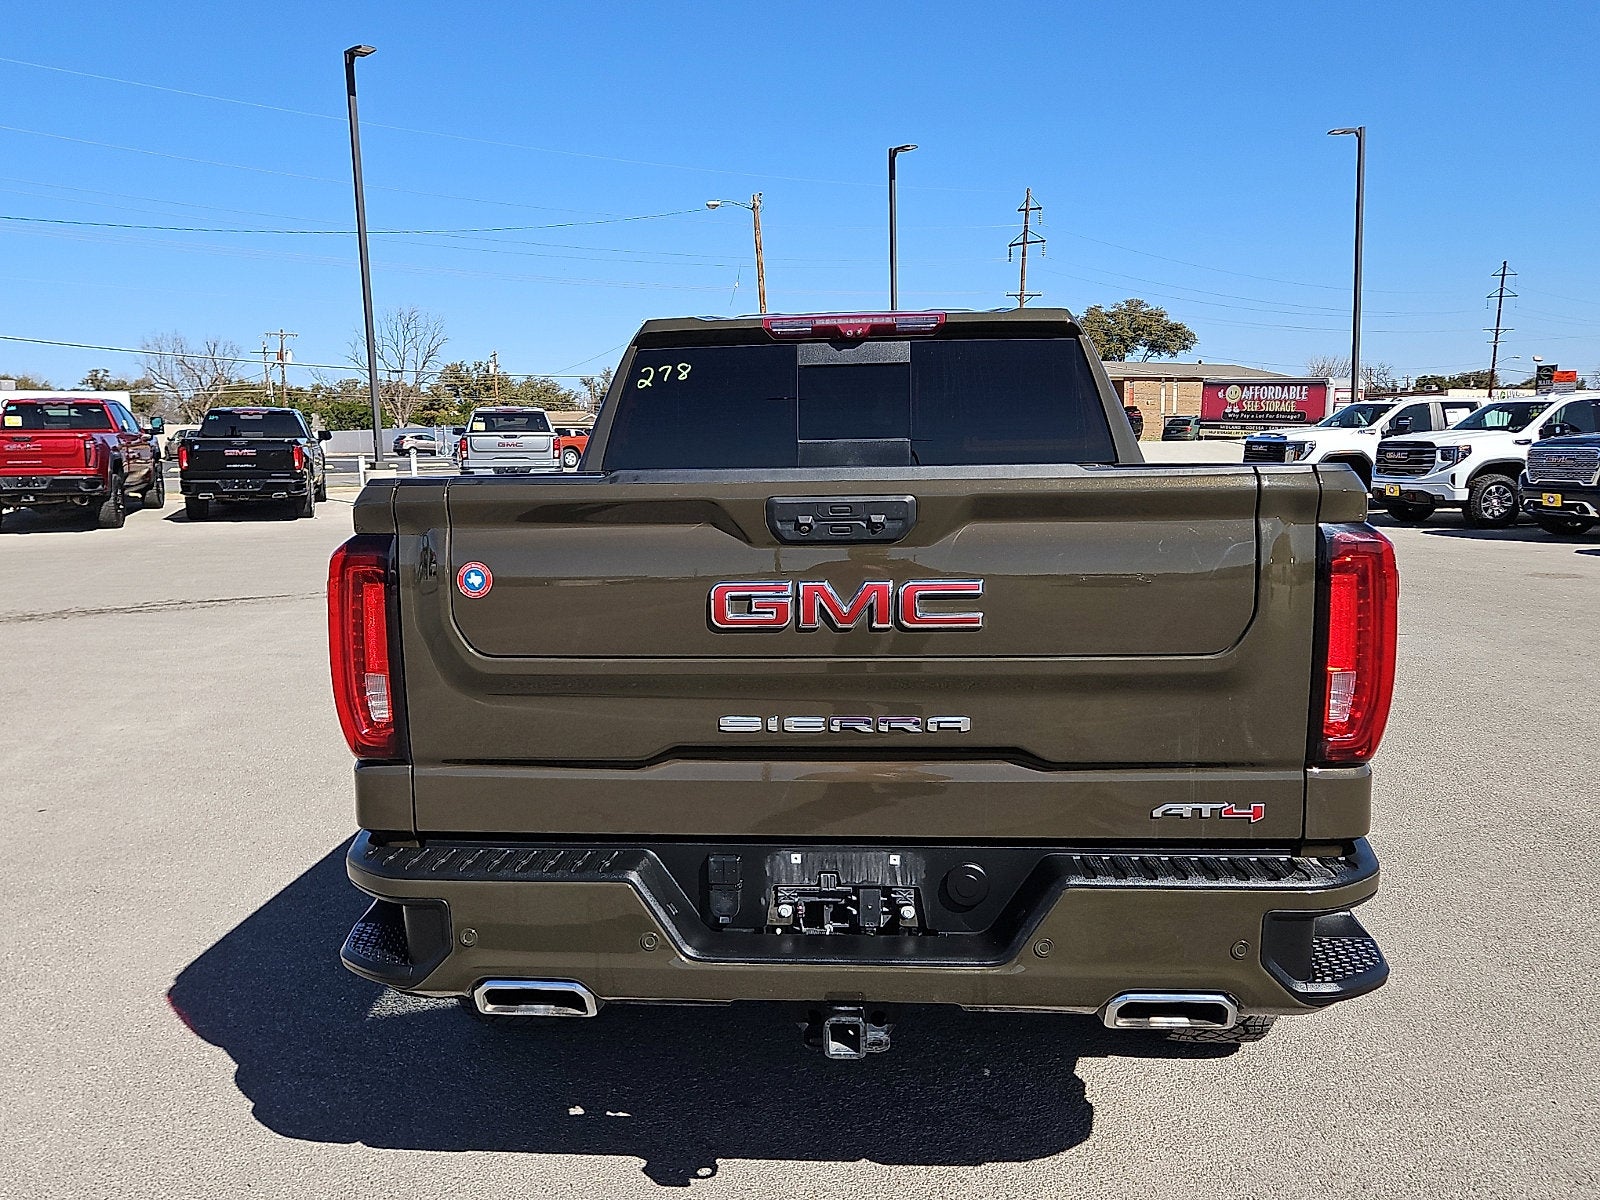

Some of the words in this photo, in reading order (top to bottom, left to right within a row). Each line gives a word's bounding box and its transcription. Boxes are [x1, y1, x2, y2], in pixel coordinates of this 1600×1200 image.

[637, 363, 692, 389] 278
[1241, 385, 1309, 400] AFFORDABLE
[1242, 400, 1260, 412] SELF
[1260, 400, 1297, 412] STORAGE
[1228, 412, 1239, 420] Why
[1240, 412, 1250, 420] Pay
[1545, 455, 1576, 464] GMC
[709, 579, 984, 631] GMC
[718, 715, 972, 733] SIERRA
[1152, 803, 1265, 823] AT4
